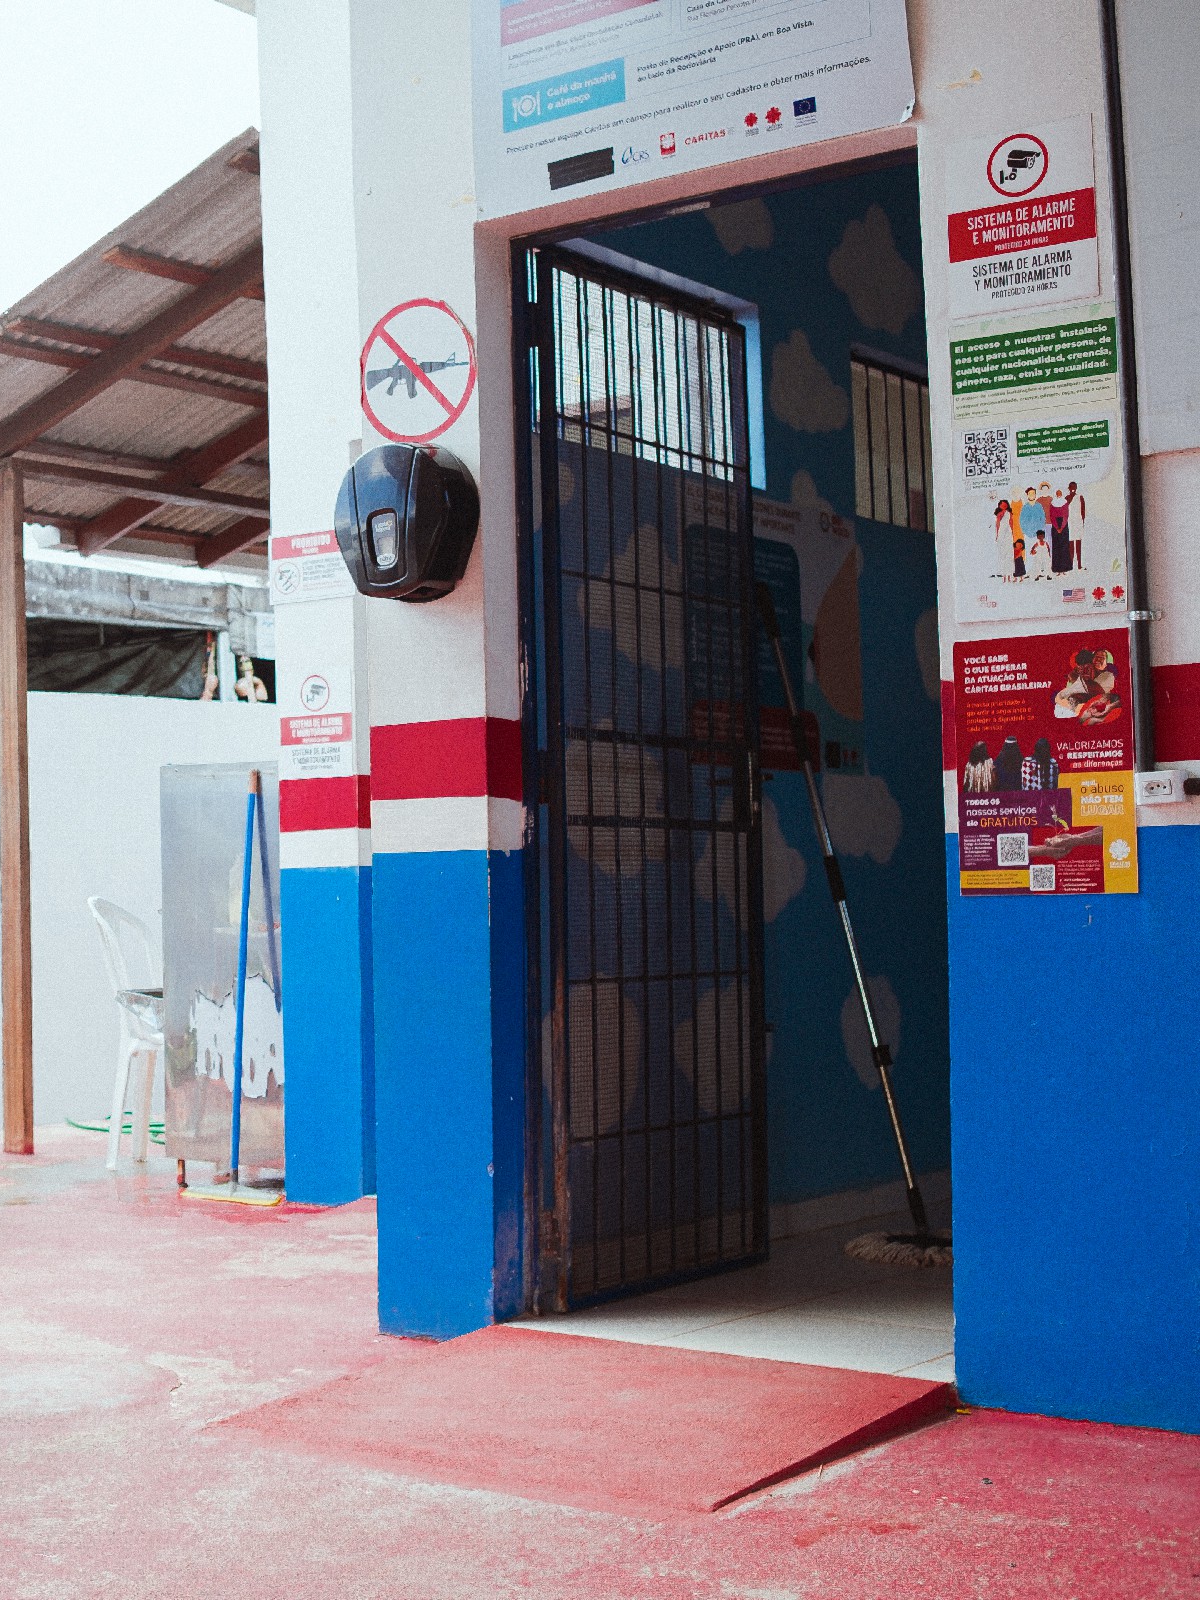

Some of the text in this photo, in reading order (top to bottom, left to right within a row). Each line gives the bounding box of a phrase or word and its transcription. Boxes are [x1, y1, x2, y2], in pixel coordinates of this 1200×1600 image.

[659, 59, 668, 67] de
[670, 48, 706, 63] Recepção
[715, 41, 736, 53] Apoio
[762, 31, 774, 39] em
[777, 27, 791, 35] Boa
[676, 56, 716, 71] Rodoviária
[546, 71, 617, 97] Café da manhã
[555, 93, 591, 108] almoço
[558, 130, 583, 143] equipe
[612, 119, 624, 127] em
[626, 112, 652, 126] campo
[653, 107, 671, 119] para
[672, 98, 702, 112] realizar
[710, 93, 725, 102] seu
[726, 83, 762, 98] cadastro
[770, 76, 793, 87] obter
[794, 69, 815, 81] mais
[816, 55, 872, 75] informações.
[967, 198, 1076, 231] SISTEMA DE ALARME
[972, 214, 1075, 246] E MONITORAMENTO
[972, 250, 1073, 278] SISTEMA DE ALARMA
[974, 264, 1071, 292] Y MONITORAMIENTO
[1027, 285, 1035, 293] 24
[1036, 282, 1058, 293] HORAS
[955, 324, 1107, 354] El acceso a nuestras instalacio
[973, 355, 984, 363] es
[986, 352, 1007, 362] para
[1008, 344, 1054, 360] cualquier
[1055, 339, 1098, 353] persona,
[1099, 335, 1111, 345] de
[955, 346, 1112, 378] cualquier nacionalidad, creencia,
[956, 375, 992, 389] género,
[993, 372, 1016, 383] raza,
[1018, 367, 1043, 378] etnia
[1053, 361, 1109, 375] sexualidad.
[964, 654, 1008, 665] VOCÊ SABE
[964, 663, 1027, 675] O QUE ESPERAR
[965, 672, 1028, 685] DA ATUAÇÃO DA
[965, 680, 1051, 694] CÁRITAS BRASILEIRA?
[1056, 739, 1124, 751] VALORIZAMOS
[1066, 750, 1123, 760] RESPEITAMOS
[1084, 759, 1123, 769] diferenças
[1081, 783, 1124, 794] o abuso
[1080, 794, 1123, 804] NÃO TEM
[966, 805, 1037, 817] nossos serviços
[1080, 804, 1125, 816] LUGAR
[966, 816, 1038, 828] são GRATUITOS
